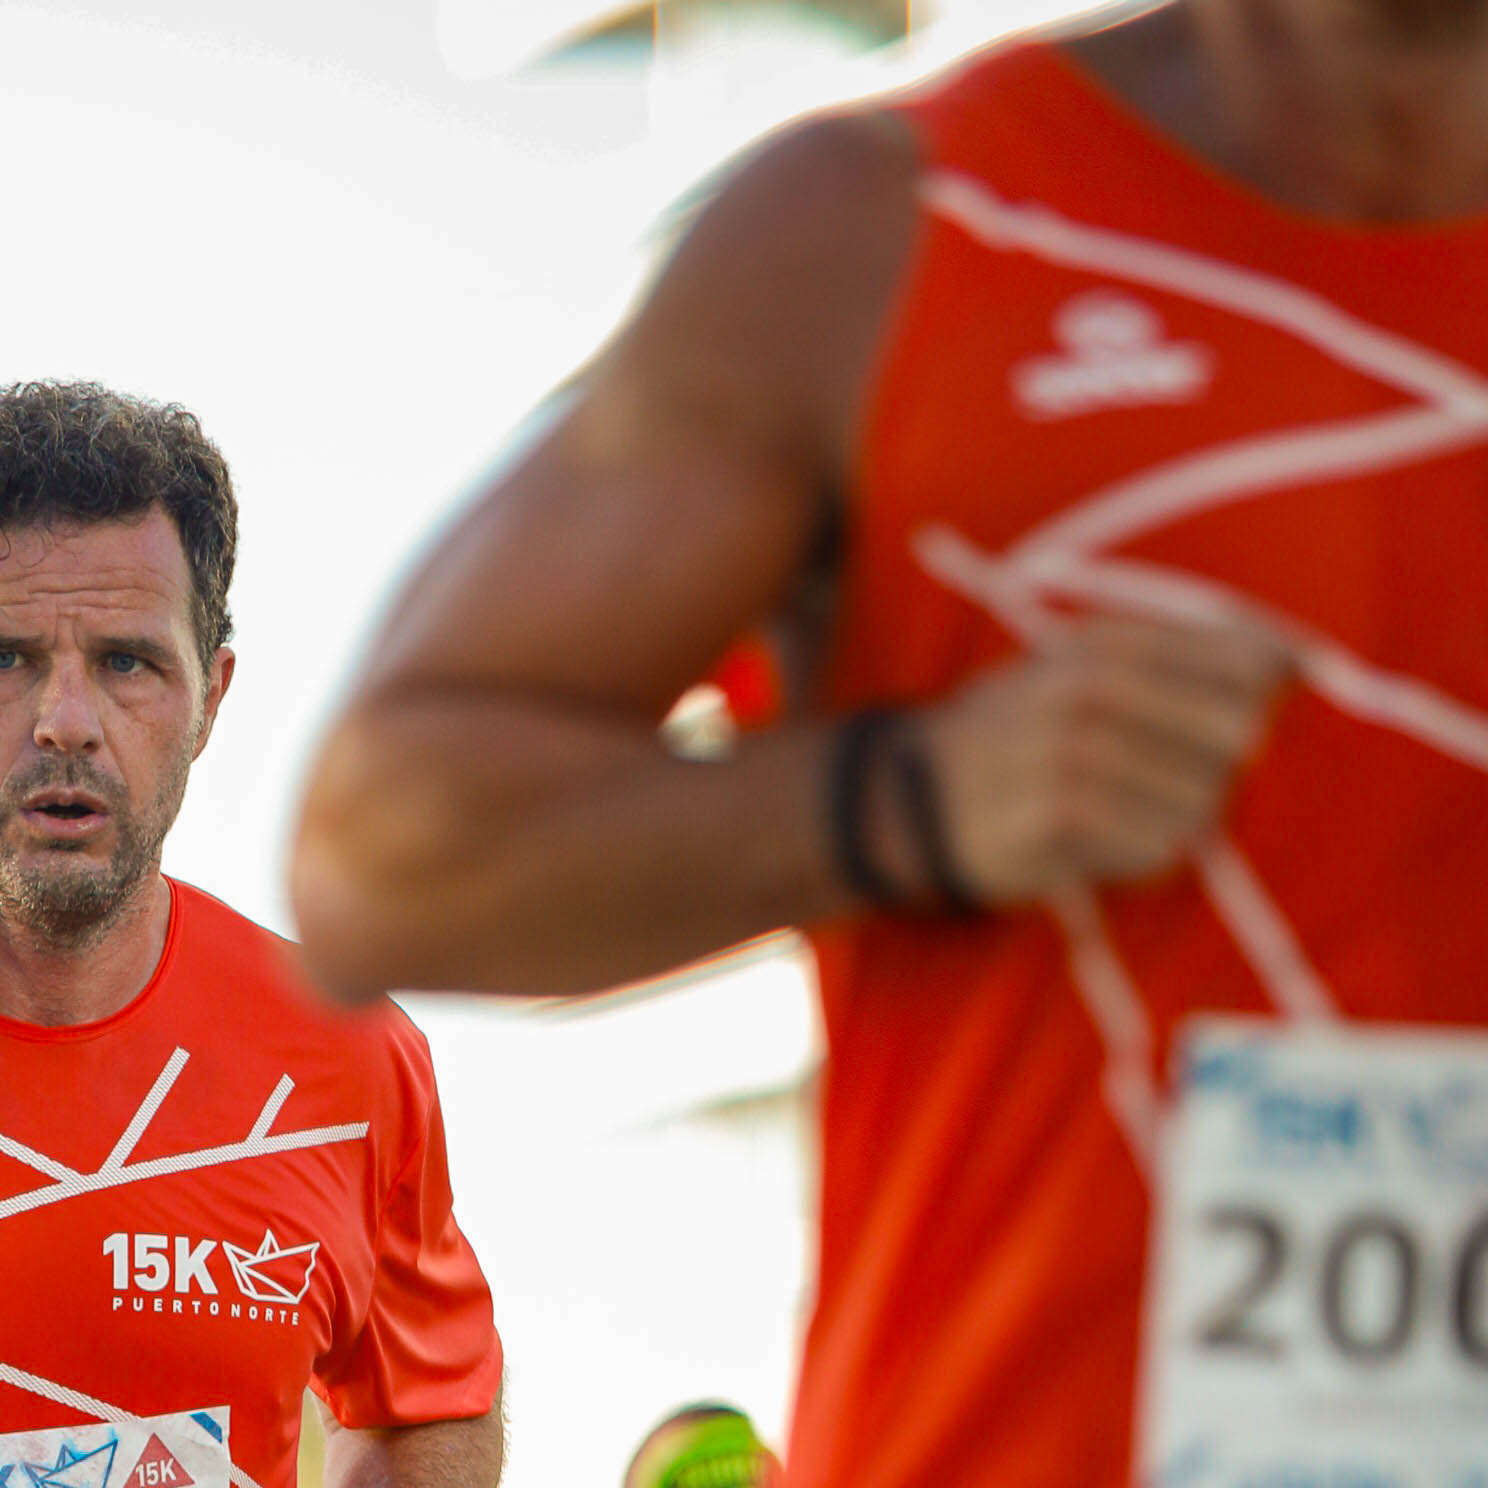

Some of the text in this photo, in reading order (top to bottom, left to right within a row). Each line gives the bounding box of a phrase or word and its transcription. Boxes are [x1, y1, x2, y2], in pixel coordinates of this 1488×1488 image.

[102, 1232, 219, 1295] 15K
[112, 1297, 300, 1326] PUERTO NORTE
[135, 1458, 178, 1488] 15K
